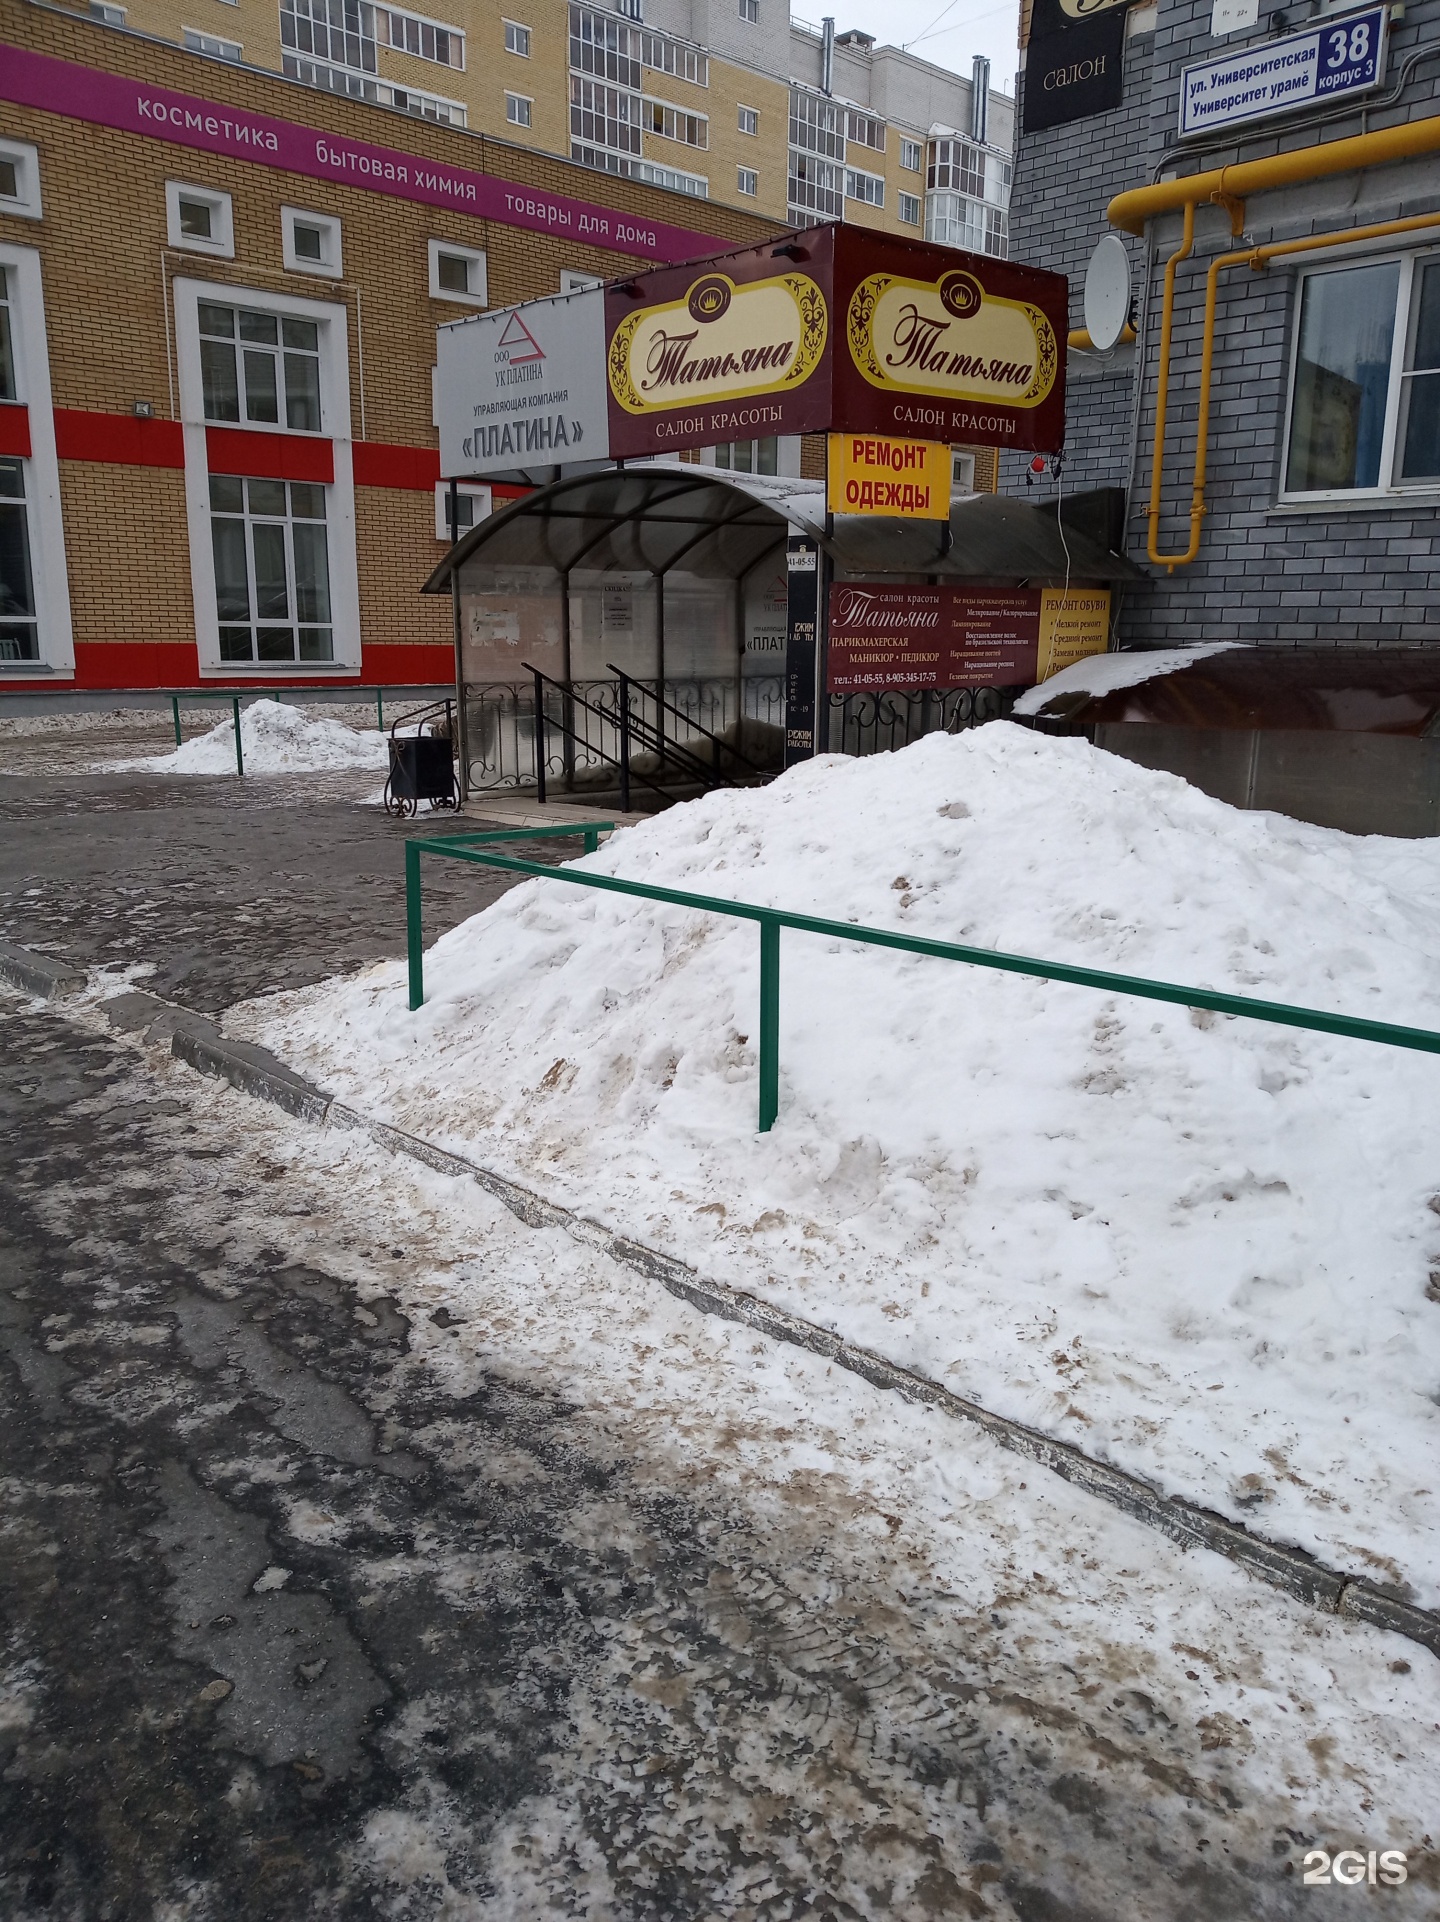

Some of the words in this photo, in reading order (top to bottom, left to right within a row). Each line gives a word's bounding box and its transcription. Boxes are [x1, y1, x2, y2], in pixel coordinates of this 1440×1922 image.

[1327, 23, 1370, 68] 38
[1043, 55, 1106, 91] салон
[1190, 79, 1207, 98] ул.
[1211, 47, 1316, 89] Университетская
[1319, 66, 1362, 90] корпус
[1365, 59, 1374, 76] 3
[1193, 86, 1267, 117] Университет
[137, 97, 278, 151] косметика
[316, 140, 408, 184] бытовая
[415, 170, 477, 201] химия
[505, 193, 571, 225] товары
[578, 214, 609, 234] для
[616, 224, 656, 247] дома
[494, 350, 510, 363] ООО
[885, 303, 1034, 385] Татьяна
[495, 371, 507, 387] УК
[507, 363, 544, 386] ПЛАТИНА
[641, 329, 794, 391] Татьяна
[473, 397, 527, 417] УПРАВЛЯЮЩАЯ
[528, 390, 569, 408] КОМПАНИЯ
[655, 416, 704, 438] САЛОН
[711, 405, 783, 430] КРАСОТЫ
[893, 405, 945, 426] САЛОН
[952, 412, 1016, 434] КРАСОТЫ
[852, 439, 927, 472] РЕМОНТ
[846, 479, 930, 512] ОДЕЖДЫ
[832, 588, 940, 628] Татьяна
[879, 594, 904, 603] салон
[907, 594, 940, 606] красоты
[1046, 599, 1079, 611] РЕМОНТ
[1080, 600, 1107, 612] ОБУВИ
[1080, 620, 1101, 630] ремонт
[1081, 634, 1102, 644] ремонт
[747, 637, 785, 651] «ПЛАТ
[831, 637, 909, 648] ПАРИКМАХЕРСКАЯ
[849, 653, 895, 663] МАНИКЮР
[901, 652, 940, 664] ПЕДИКЮР
[885, 672, 937, 683] 8-905-345-17-75
[788, 729, 812, 740] РЕЖИМ
[788, 740, 812, 748] РАБОТЫ
